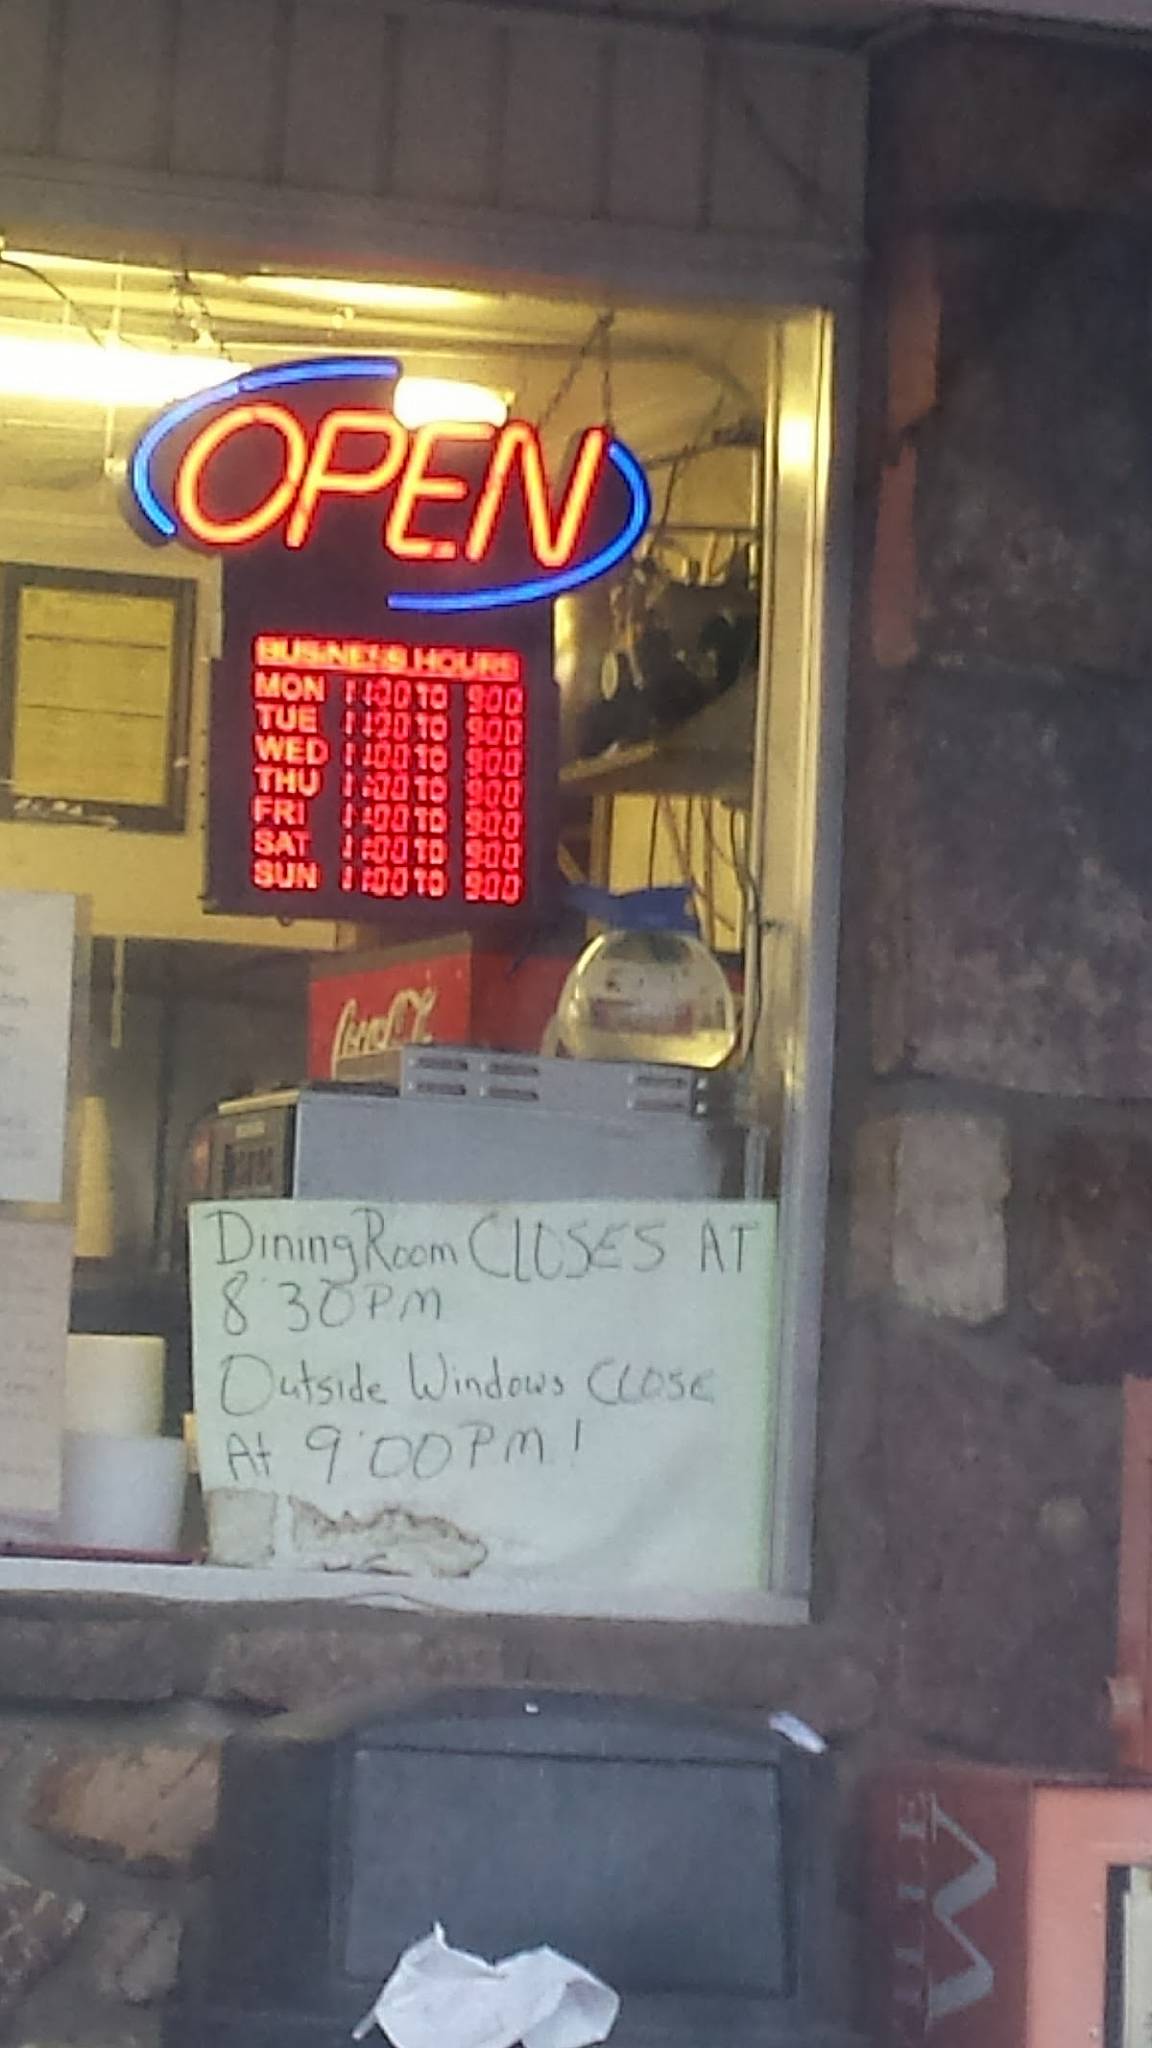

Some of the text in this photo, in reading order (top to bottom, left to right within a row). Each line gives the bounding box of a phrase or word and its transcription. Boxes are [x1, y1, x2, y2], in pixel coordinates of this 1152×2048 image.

[176, 400, 609, 567] OPEN
[254, 672, 326, 702] MON
[414, 683, 448, 710] TO
[254, 703, 318, 733] TUE
[414, 712, 448, 741] TO
[254, 734, 329, 765] WED
[414, 744, 448, 773] TO
[254, 766, 320, 797] THU
[414, 775, 448, 803] TO
[254, 796, 306, 825] FRI
[414, 806, 448, 833] TO
[254, 829, 312, 857] SAT
[413, 838, 447, 865] TO
[254, 859, 318, 889] SUN
[413, 867, 447, 897] TO
[700, 1217, 760, 1274] AT
[220, 1353, 388, 1416] Outside
[408, 1351, 564, 1401] Windows
[226, 1431, 272, 1481] At
